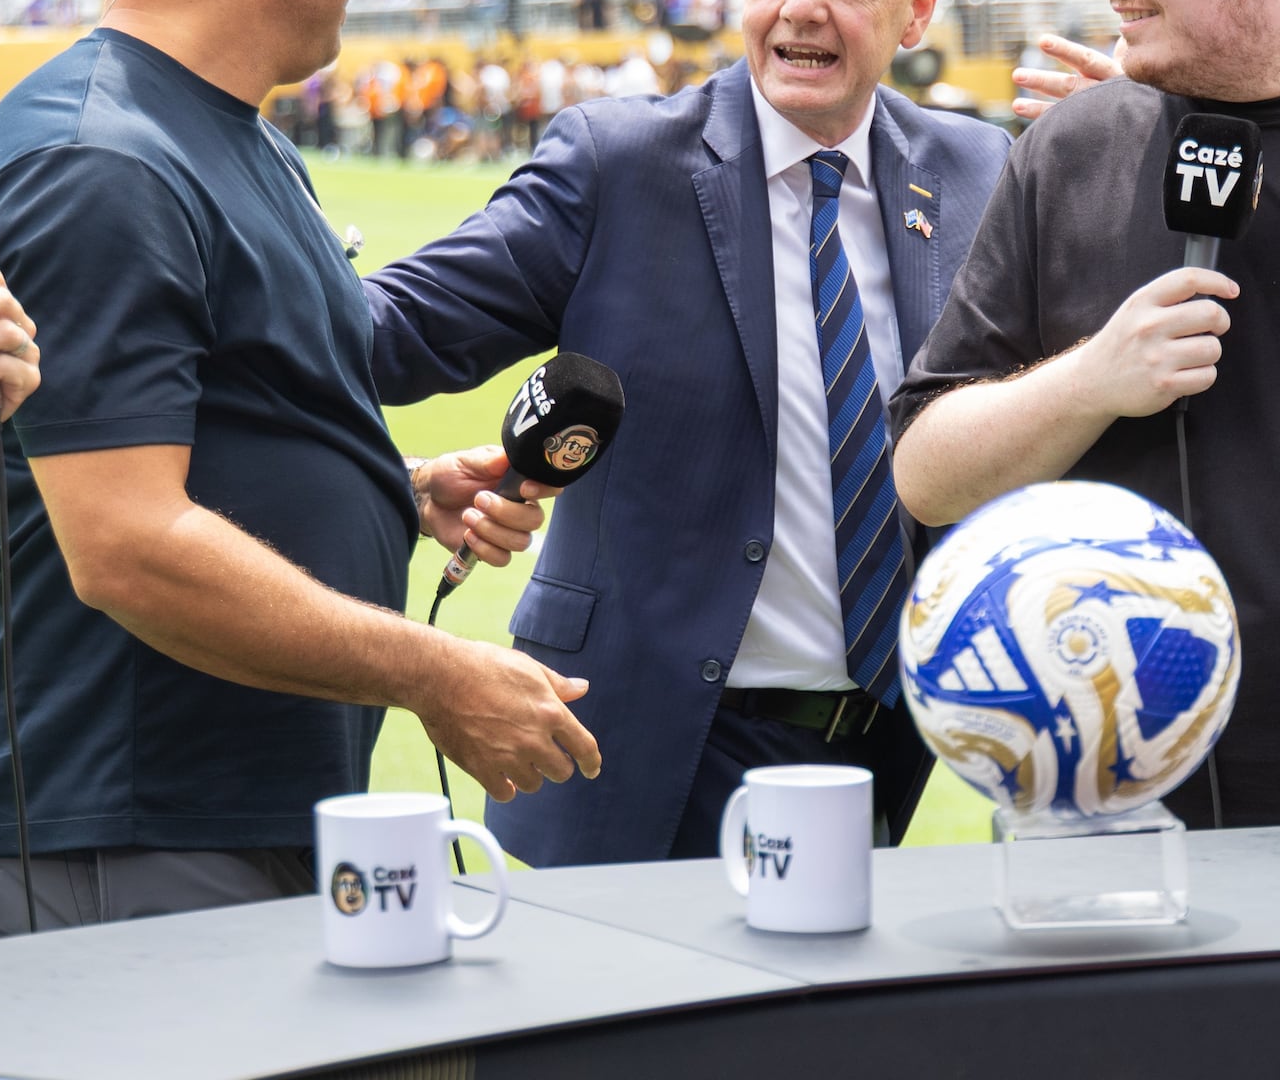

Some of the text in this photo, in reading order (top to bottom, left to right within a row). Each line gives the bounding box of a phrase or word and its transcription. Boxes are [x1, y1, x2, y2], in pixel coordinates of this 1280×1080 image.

[1178, 140, 1244, 169] Cazé
[1175, 163, 1241, 208] TV
[530, 366, 557, 416] Cazé
[509, 379, 540, 438] TV
[758, 833, 793, 852] Cazé
[373, 865, 417, 882] Cazé
[758, 850, 793, 880] TV
[374, 882, 417, 912] TV
